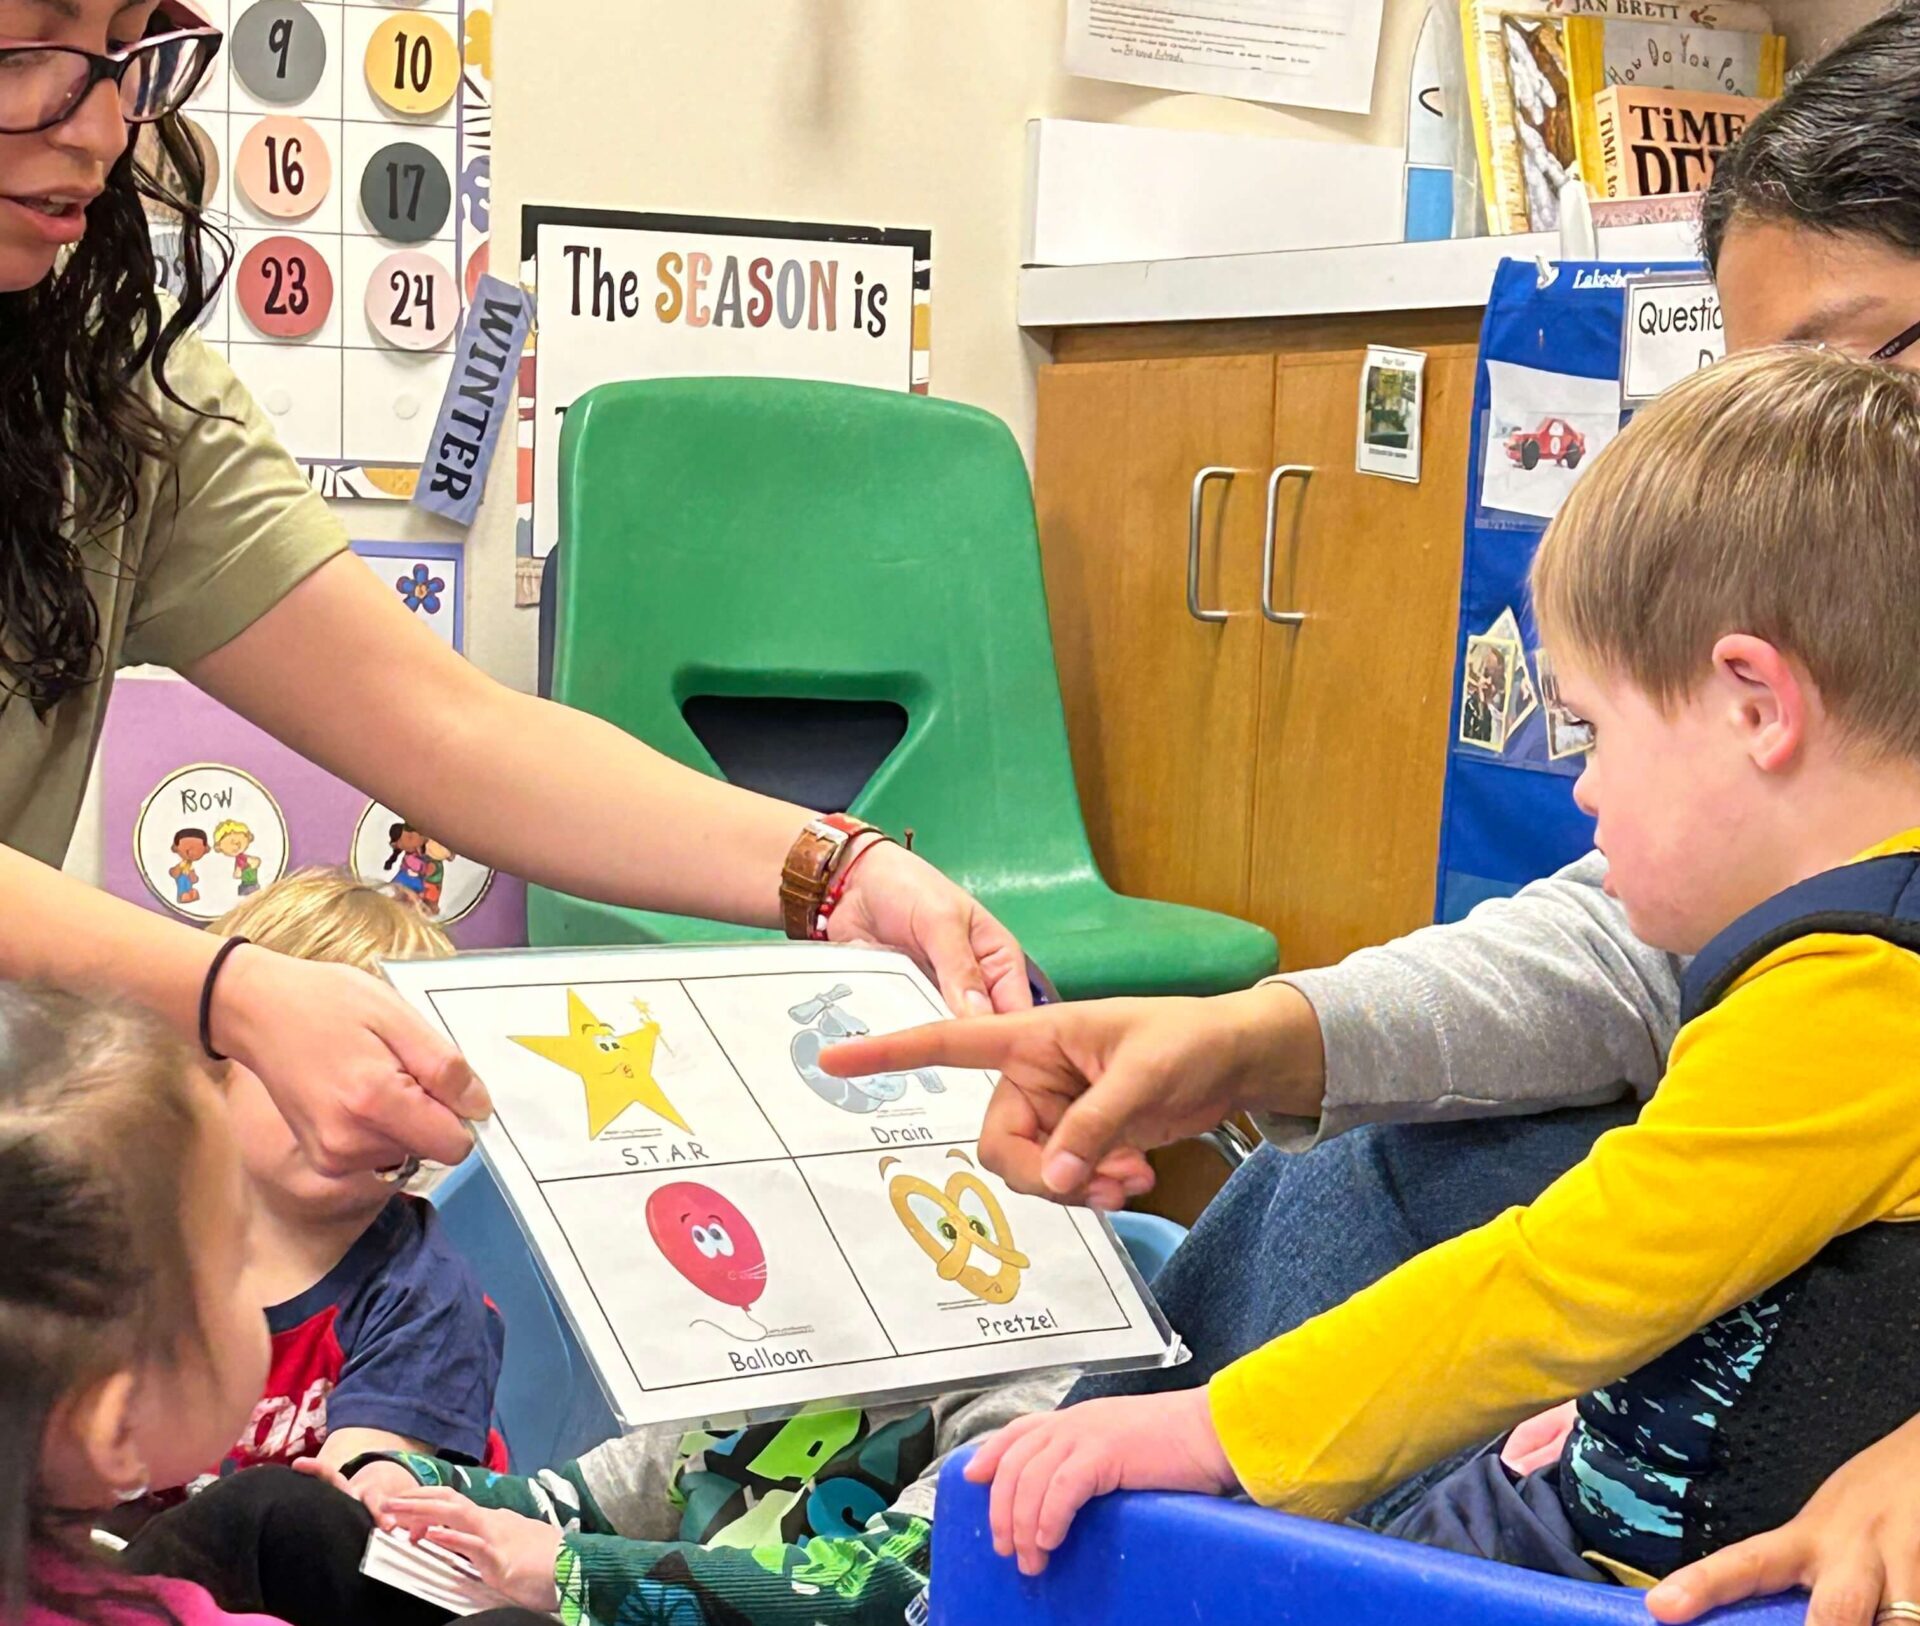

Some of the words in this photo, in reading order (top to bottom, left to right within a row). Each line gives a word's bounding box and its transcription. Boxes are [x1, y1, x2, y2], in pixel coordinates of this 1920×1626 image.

[1572, 0, 1608, 14] JAN
[1616, 0, 1680, 20] BRETT
[269, 18, 293, 79] 9
[394, 31, 433, 93] 10
[1647, 38, 1673, 67] Do
[264, 135, 305, 196] 16
[386, 161, 426, 222] 17
[261, 256, 309, 316] 23
[390, 269, 436, 331] 24
[563, 245, 639, 322] The
[655, 251, 839, 331] SEASON
[853, 269, 888, 338] is
[1572, 267, 1651, 289] Lakesh
[1638, 296, 1724, 336] Questio
[429, 297, 523, 501] WINTER
[870, 1123, 934, 1144] Drain
[976, 1308, 1059, 1337] Pretzel
[727, 1346, 814, 1372] Balloon
